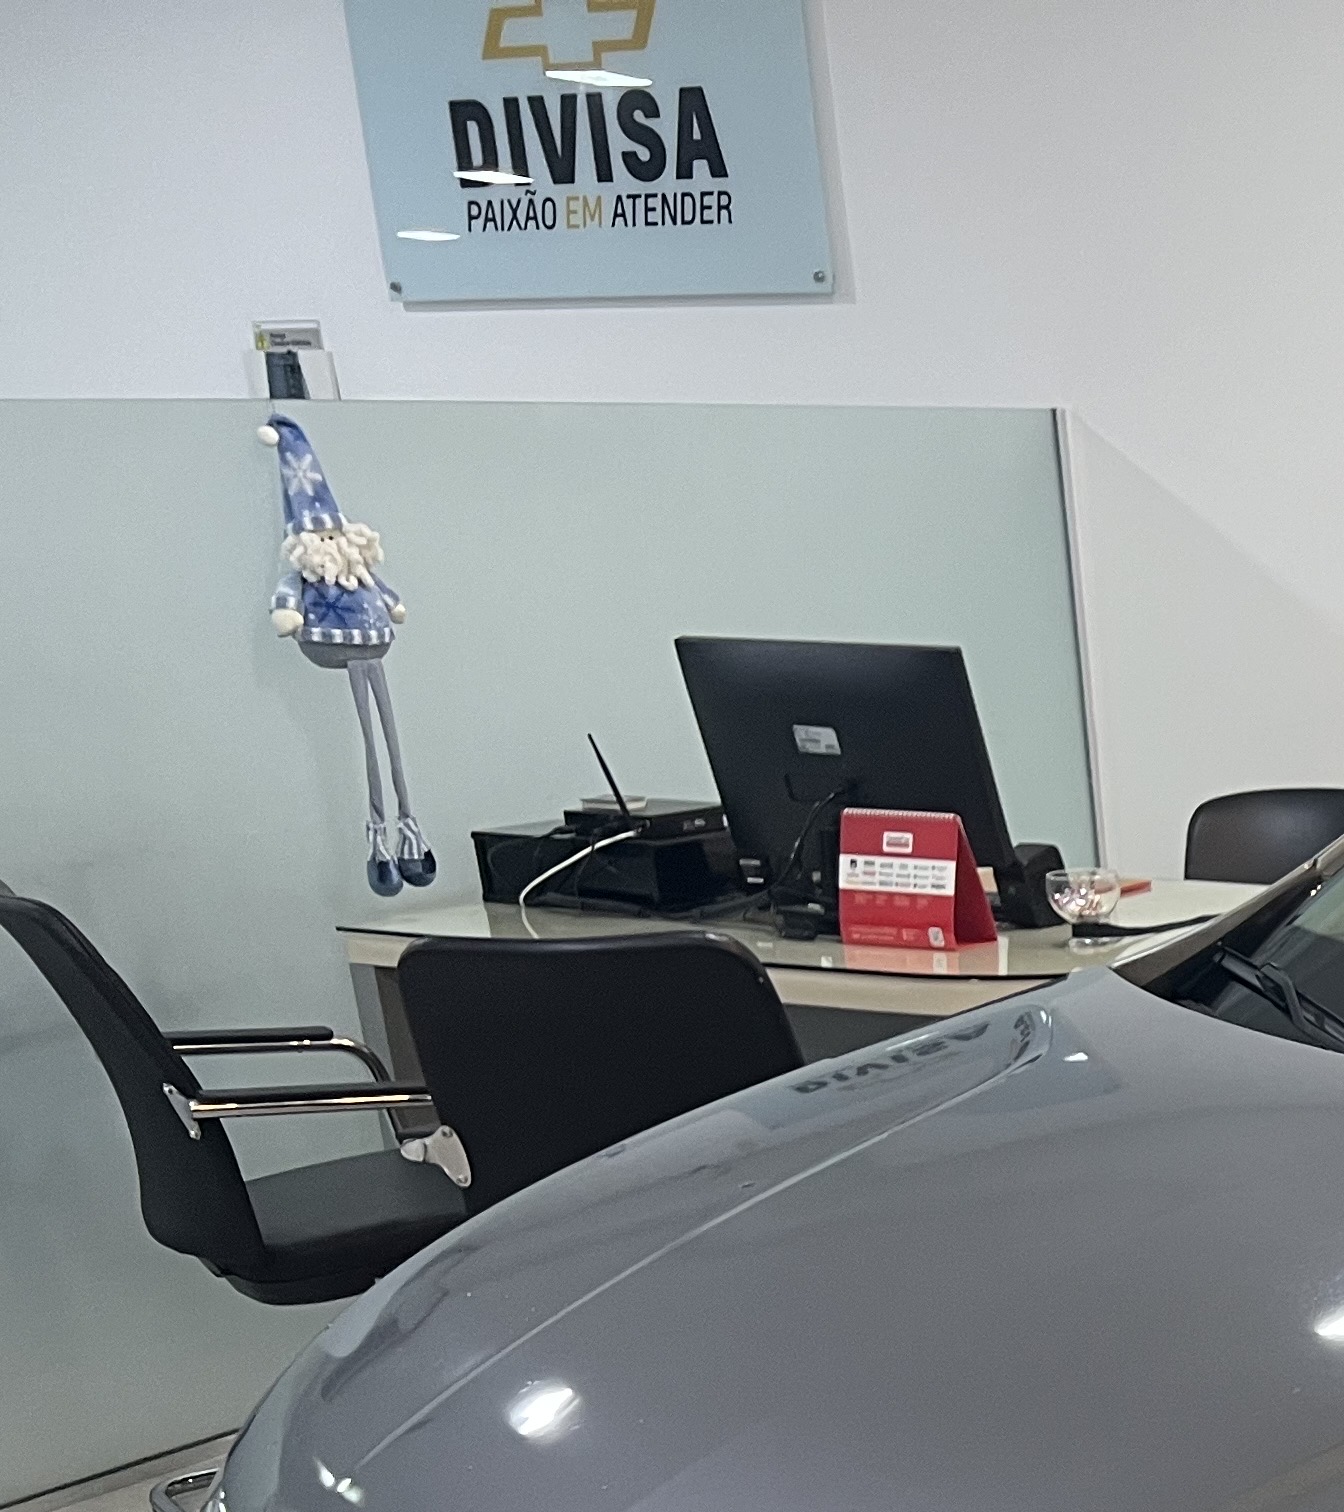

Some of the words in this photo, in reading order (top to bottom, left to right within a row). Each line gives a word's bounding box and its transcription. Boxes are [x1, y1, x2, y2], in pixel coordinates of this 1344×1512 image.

[448, 86, 729, 188] DIVISA
[467, 190, 557, 232] PAIXÃO
[566, 196, 603, 229] EM
[611, 191, 733, 229] ATENDER
